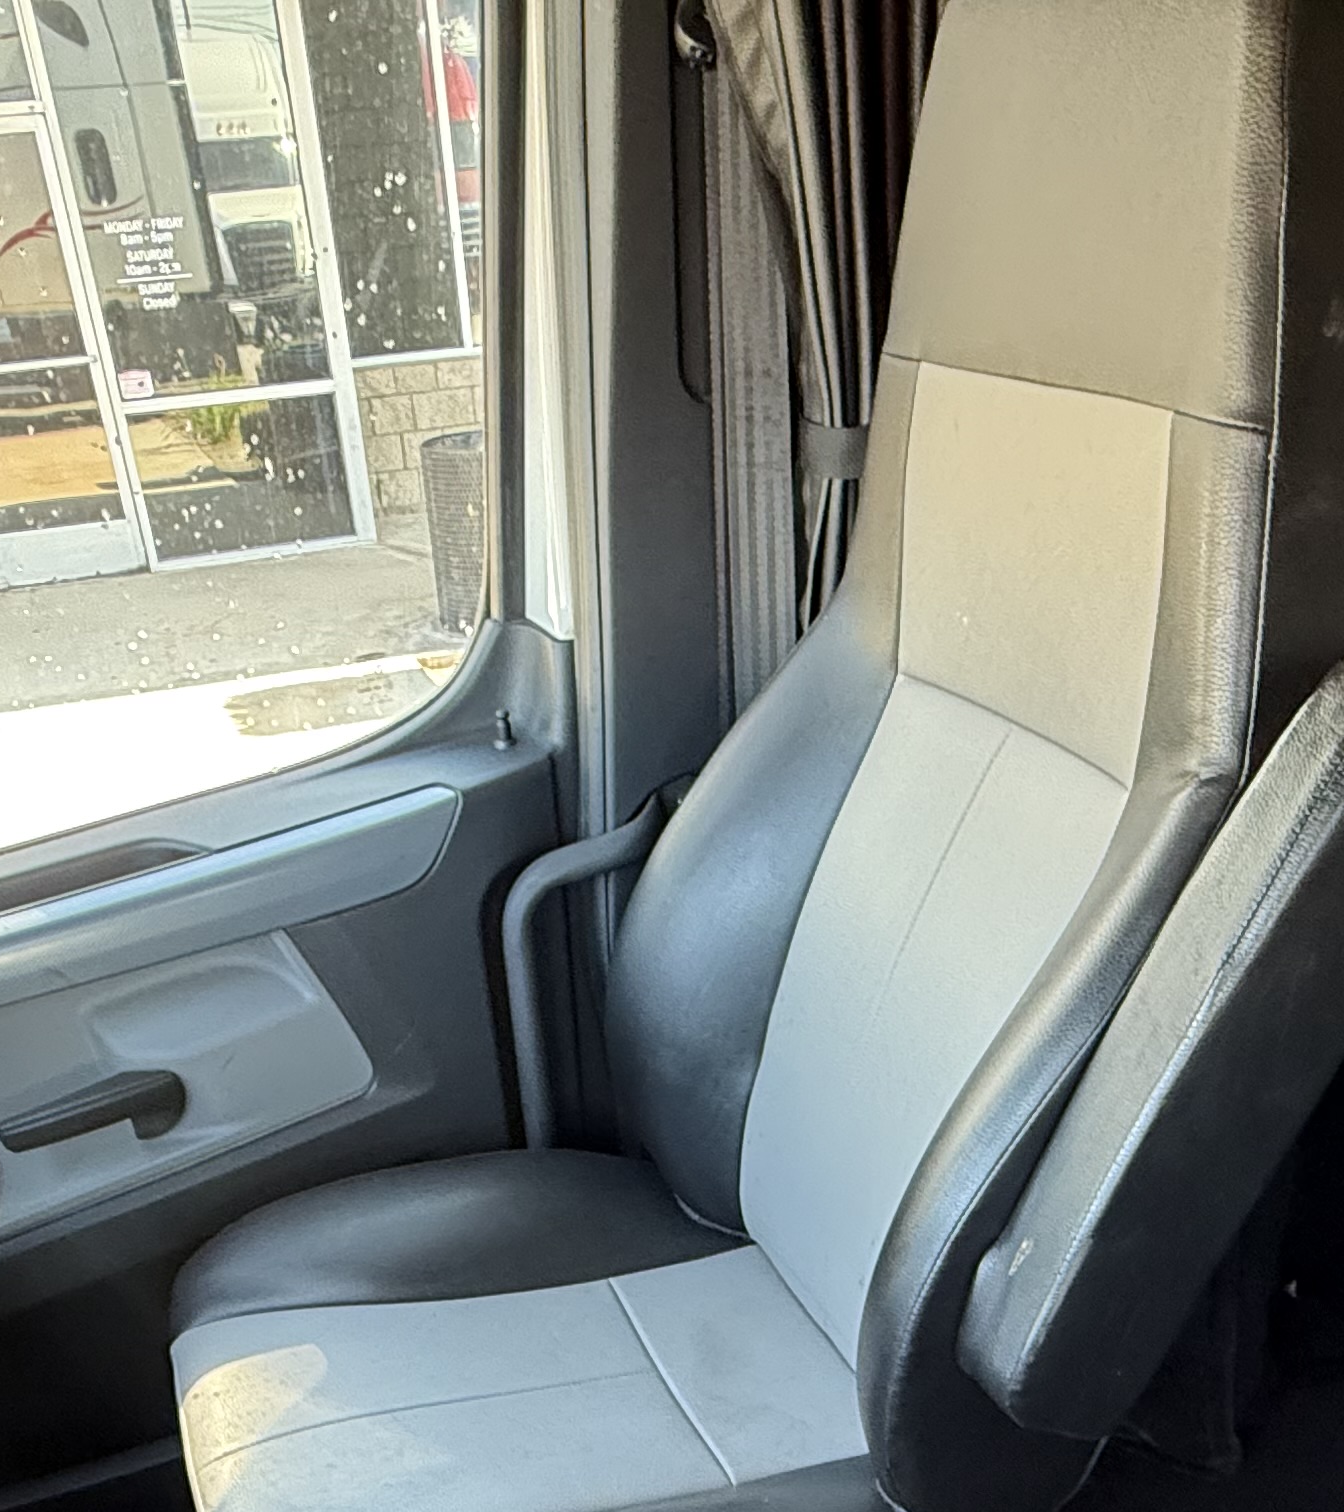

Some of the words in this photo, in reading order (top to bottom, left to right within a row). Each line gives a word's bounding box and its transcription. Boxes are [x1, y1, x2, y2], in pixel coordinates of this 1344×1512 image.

[104, 219, 143, 234] MONDAY
[151, 216, 184, 231] FRIDAY
[126, 248, 174, 263] SATURDAY
[138, 281, 175, 295] SUNDAY
[143, 295, 179, 311] Closed
